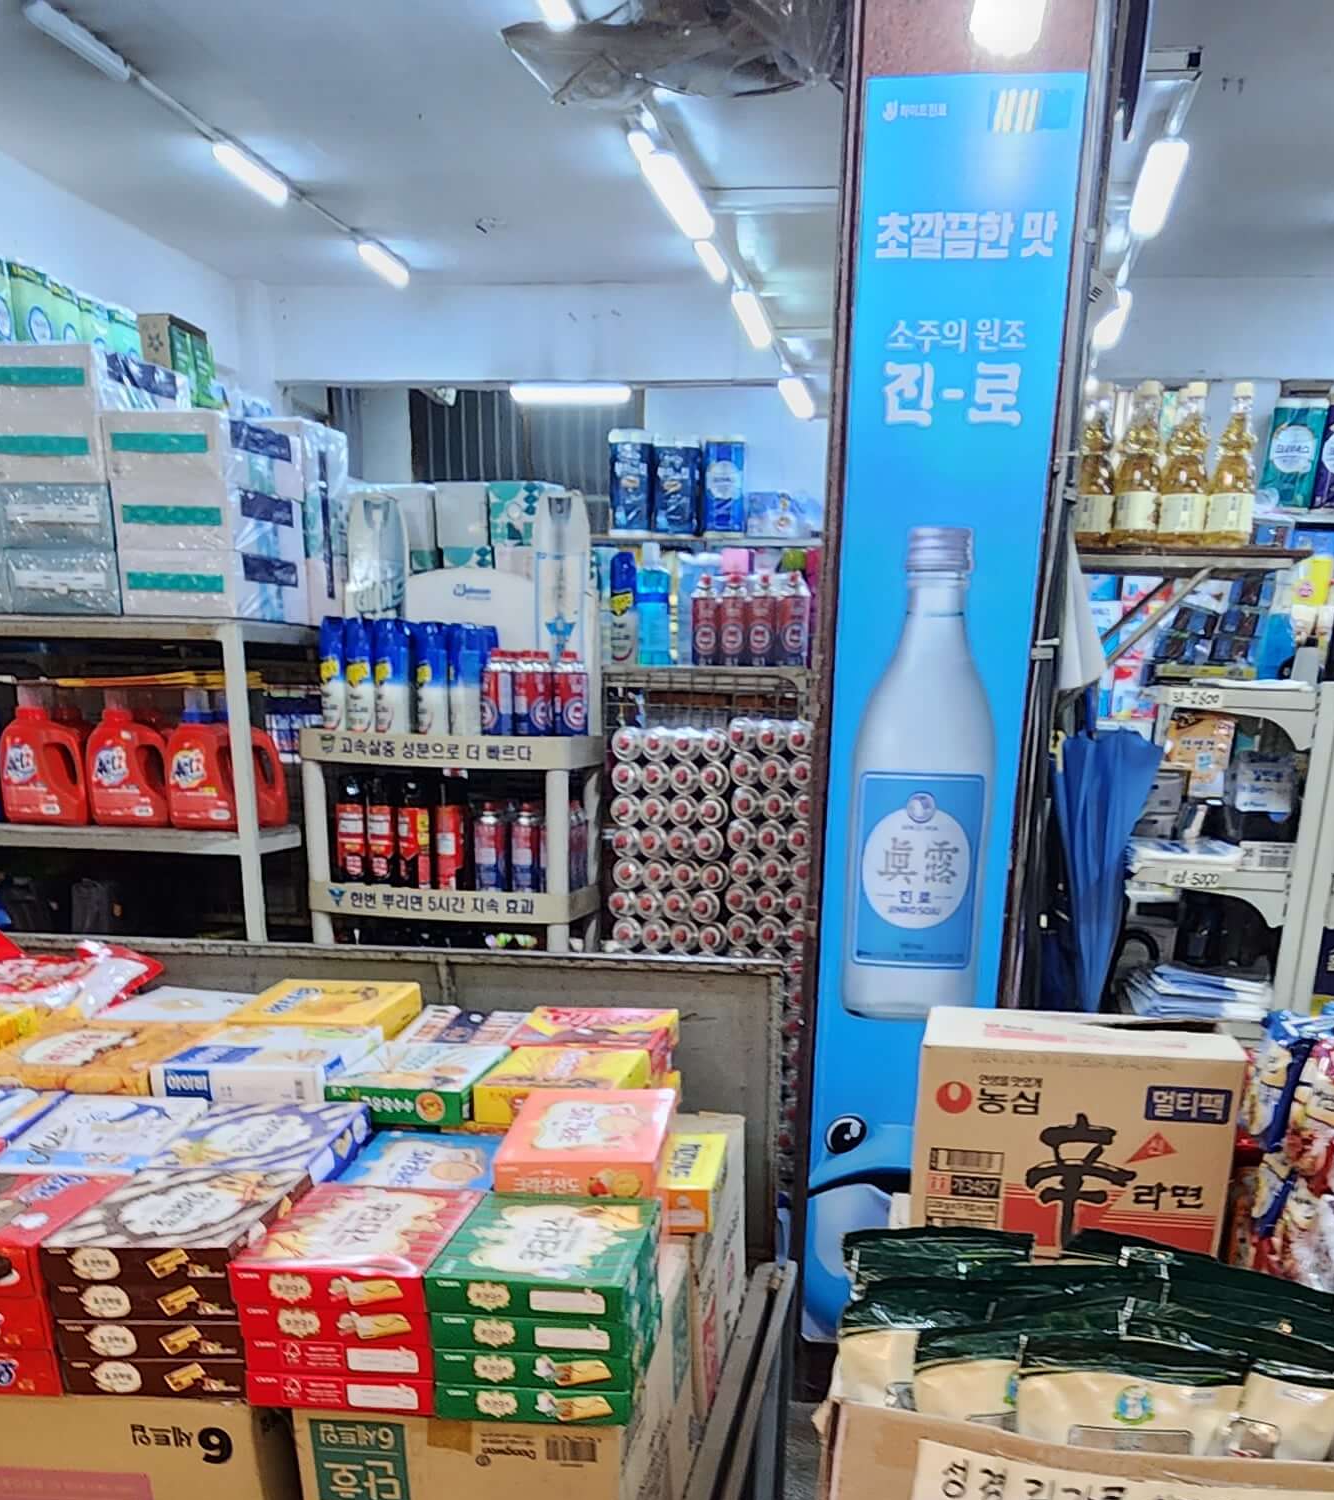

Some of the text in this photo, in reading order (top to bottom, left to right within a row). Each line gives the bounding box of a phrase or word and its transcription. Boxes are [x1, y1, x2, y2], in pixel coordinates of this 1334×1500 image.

[875, 211, 1058, 259] 초깔끔한 맛
[887, 318, 1027, 352] 소주의 원조
[341, 737, 532, 762] 고속살충 성분으로 더 빠르다
[350, 890, 377, 907] 한번
[381, 892, 424, 912] 뿌리면
[427, 896, 466, 914] 5시간
[505, 897, 535, 916] 효과
[977, 1087, 1041, 1116] 농심
[1151, 1091, 1226, 1119] 멀티팩
[1025, 1112, 1138, 1250] 辛
[1132, 1182, 1205, 1211] 라면
[322, 1459, 402, 1500] 단호
